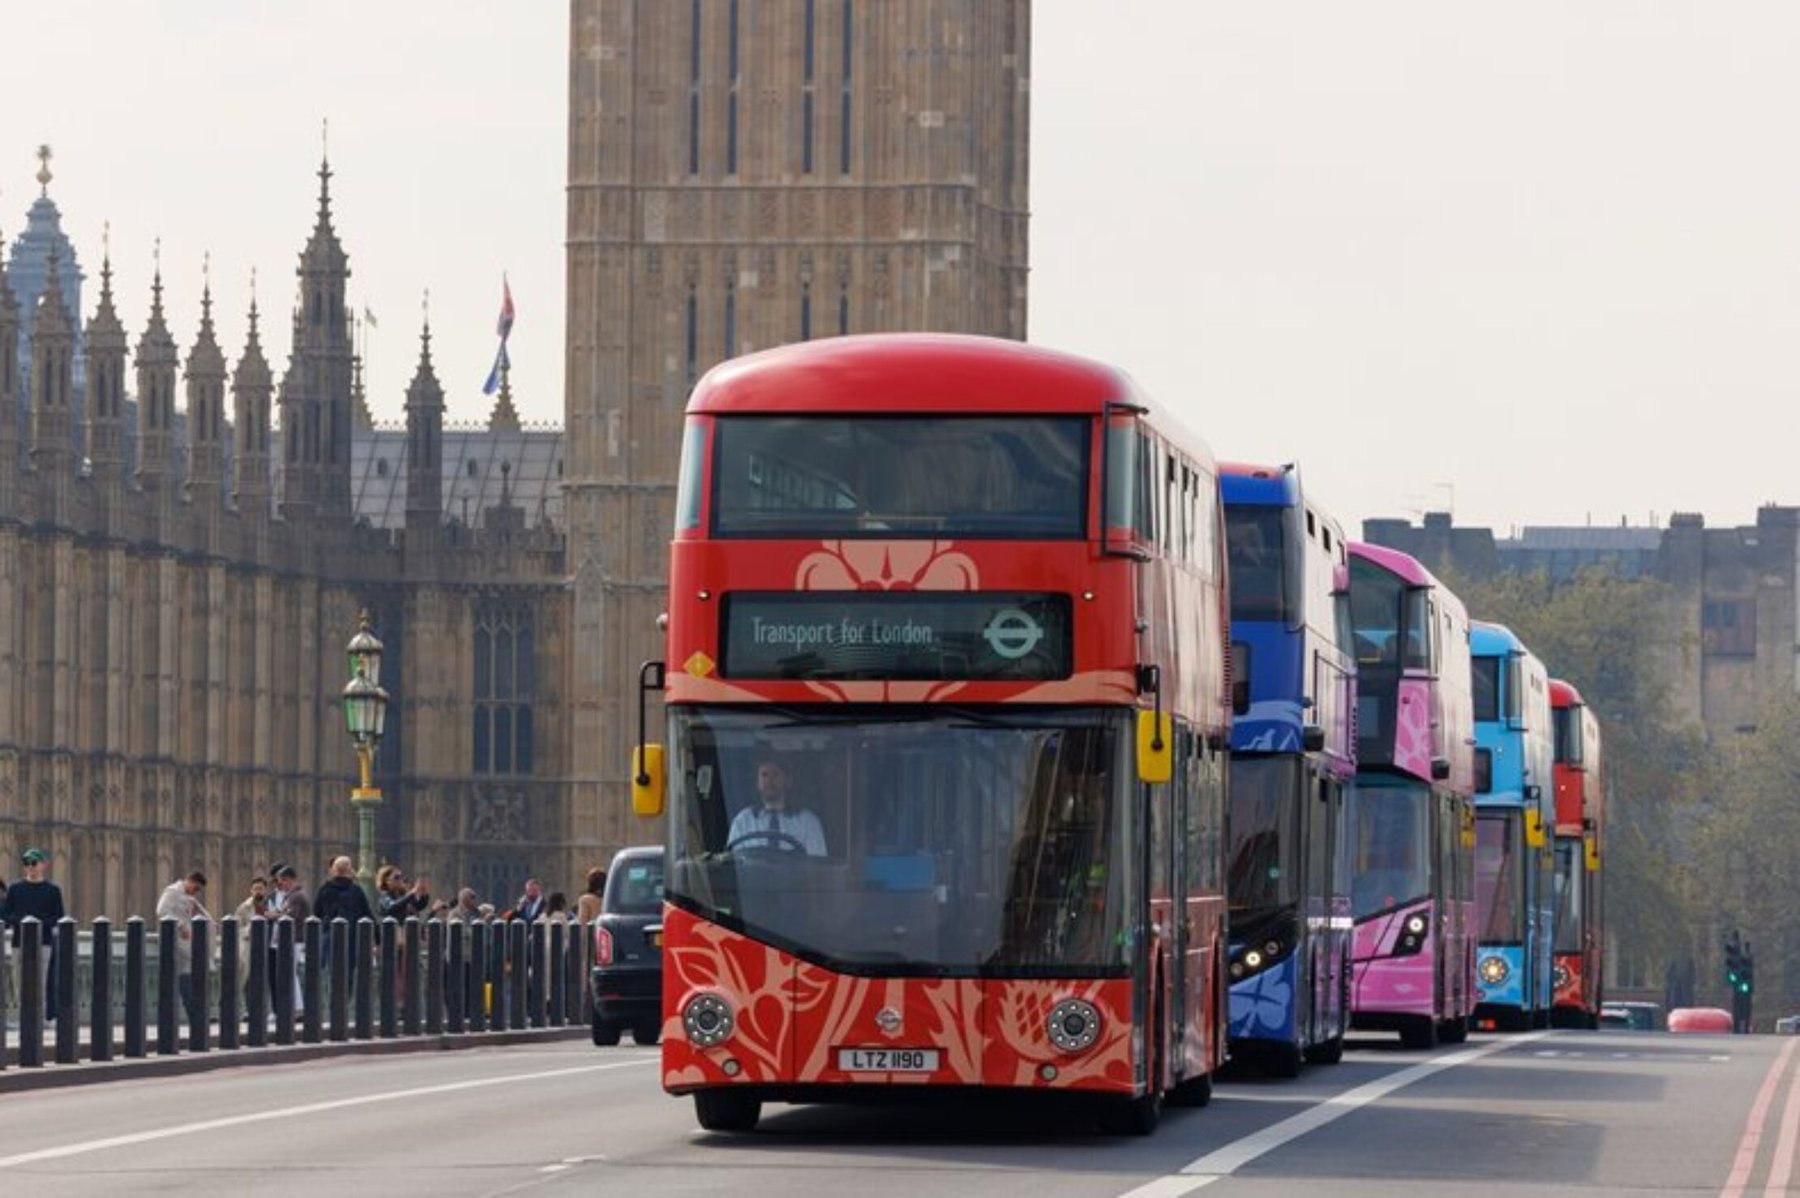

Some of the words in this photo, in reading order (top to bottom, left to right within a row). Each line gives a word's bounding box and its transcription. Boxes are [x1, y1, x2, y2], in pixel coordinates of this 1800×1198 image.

[753, 617, 834, 652] Transport
[842, 618, 865, 644] for
[872, 618, 933, 643] London
[852, 1051, 887, 1068] LTZ
[893, 1051, 924, 1069] 1190
